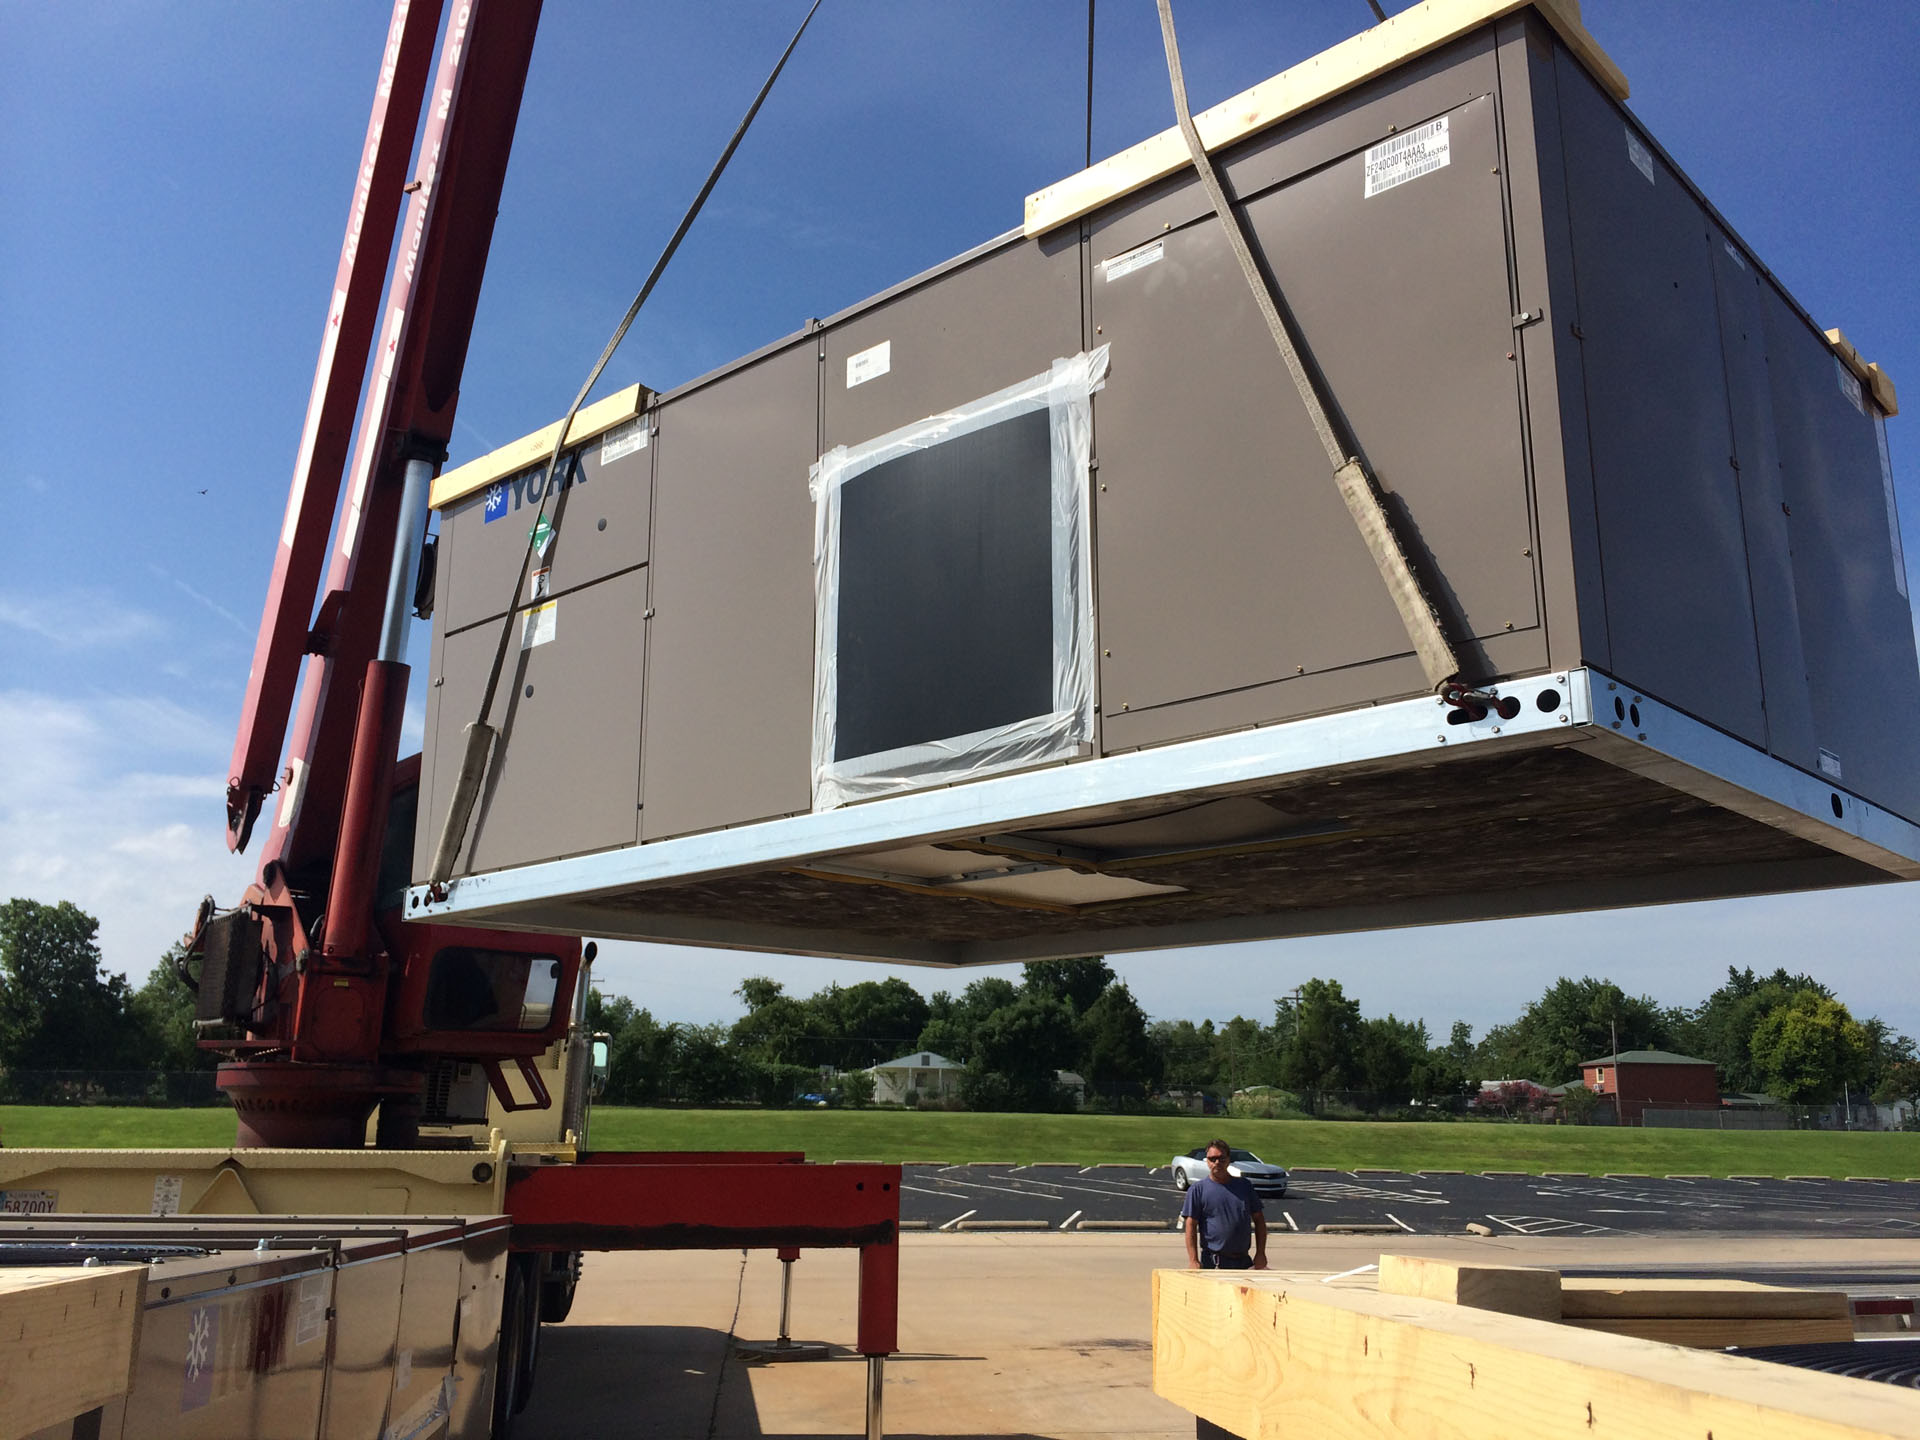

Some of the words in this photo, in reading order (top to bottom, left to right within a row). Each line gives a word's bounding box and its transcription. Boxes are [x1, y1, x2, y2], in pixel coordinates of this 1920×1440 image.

[344, 120, 382, 267] Manitex
[379, 0, 411, 98] M221
[403, 140, 440, 283] Manitex
[511, 448, 588, 511] YORK
